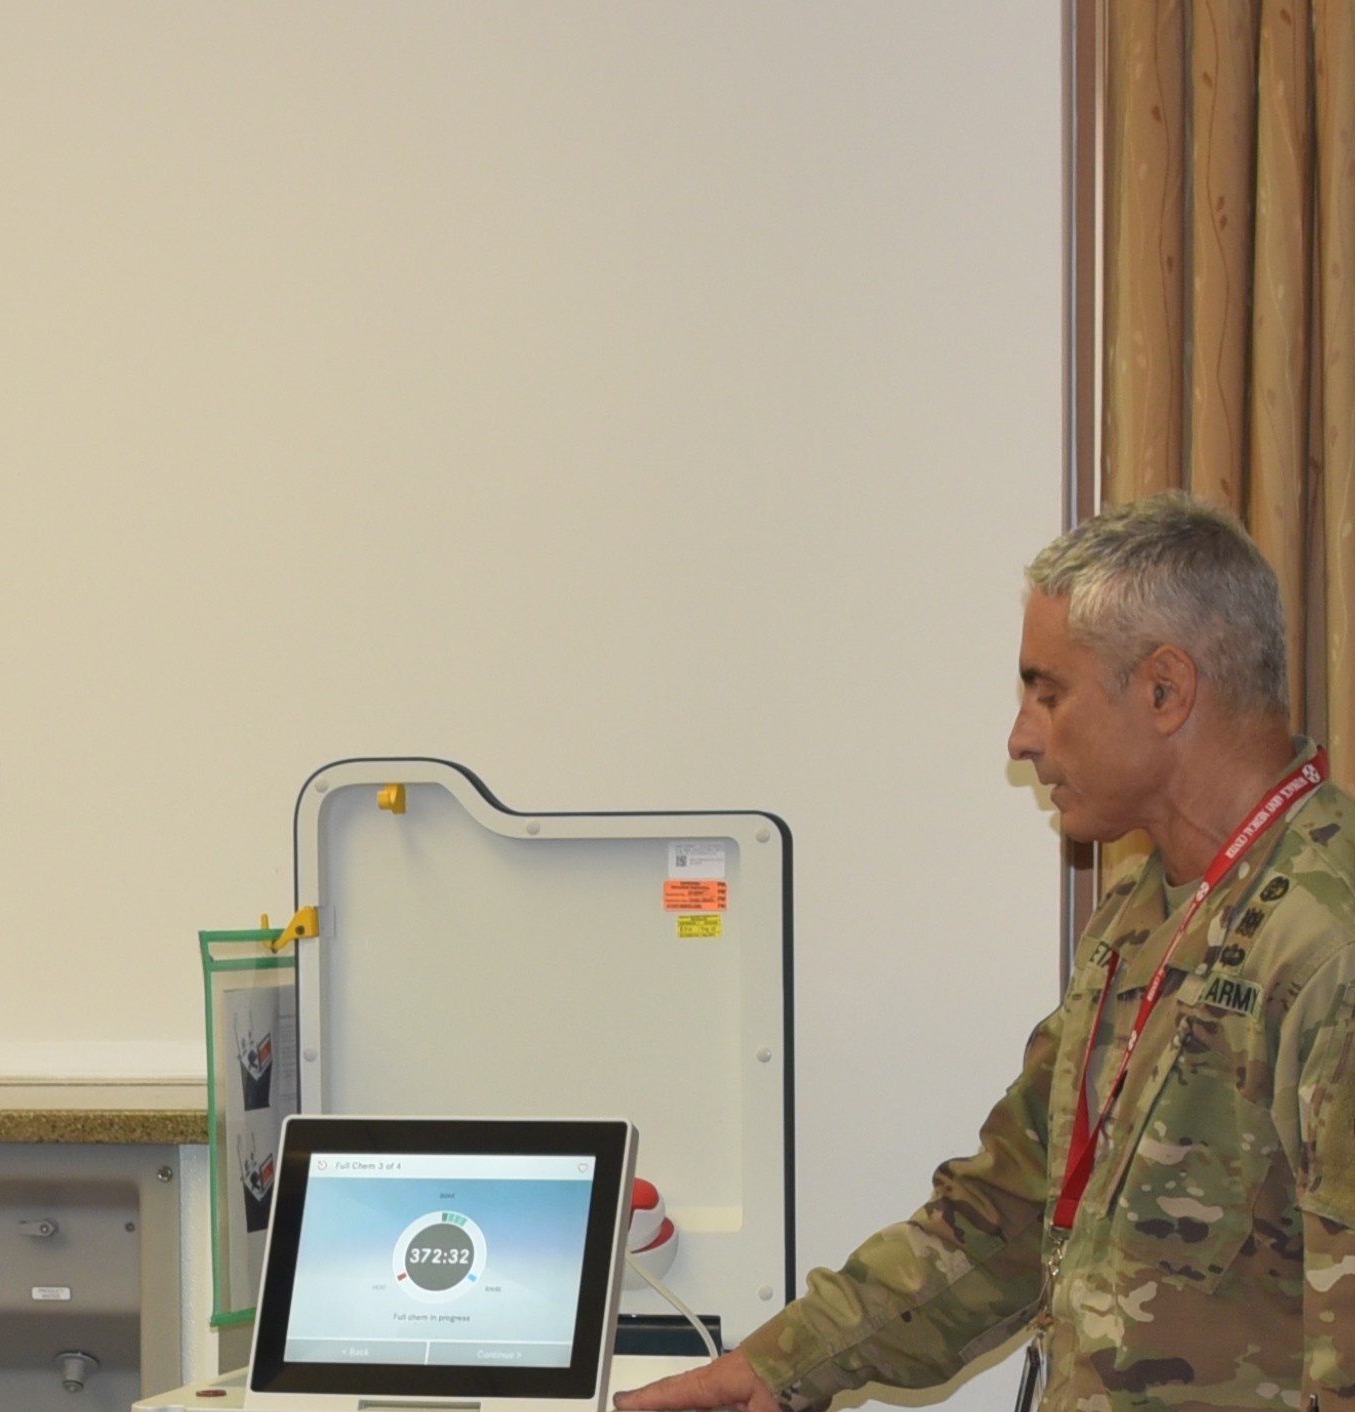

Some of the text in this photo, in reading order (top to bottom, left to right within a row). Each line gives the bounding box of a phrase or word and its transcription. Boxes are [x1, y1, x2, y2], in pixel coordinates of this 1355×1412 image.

[336, 1161, 402, 1170] Full Chem 3 of 4
[409, 1248, 470, 1264] 372:32
[438, 1314, 471, 1324] progress
[349, 1347, 369, 1357] Back
[477, 1350, 514, 1359] Continue
